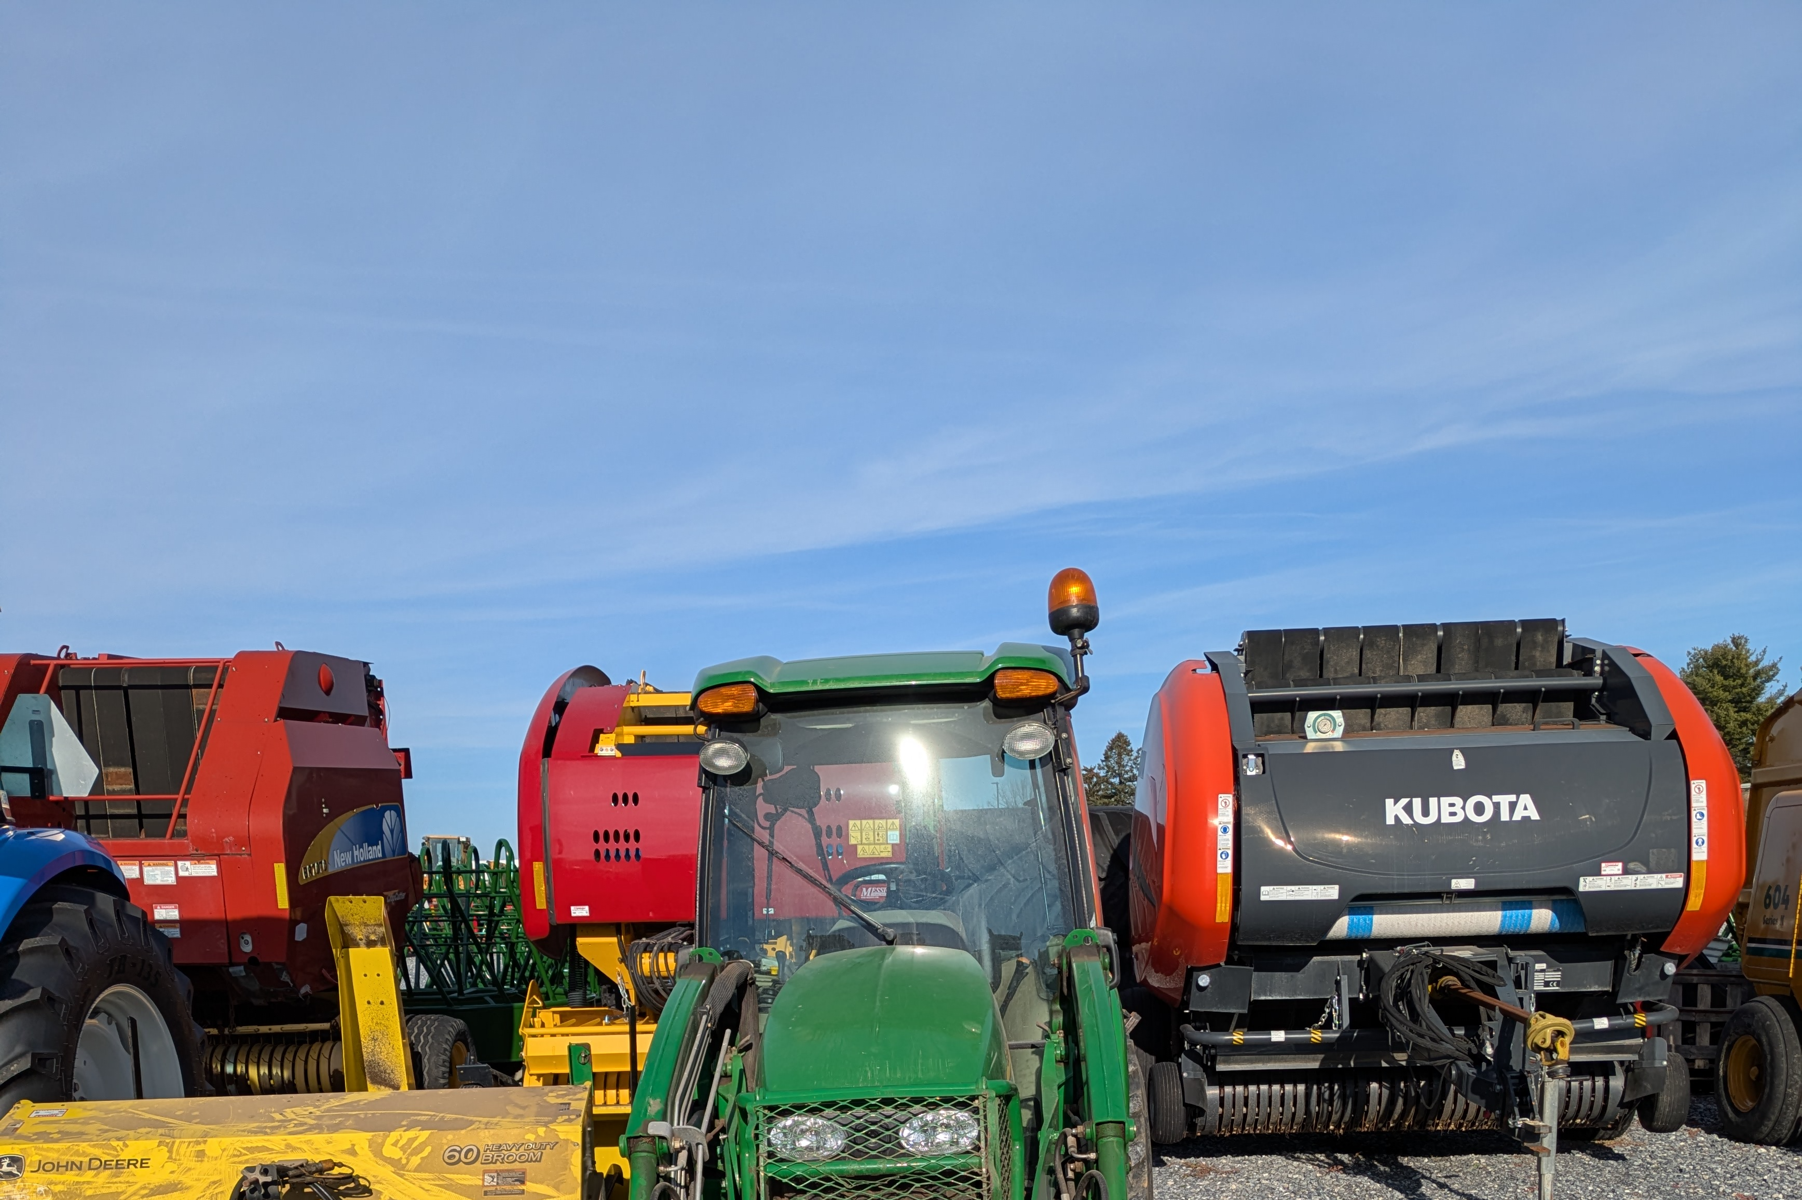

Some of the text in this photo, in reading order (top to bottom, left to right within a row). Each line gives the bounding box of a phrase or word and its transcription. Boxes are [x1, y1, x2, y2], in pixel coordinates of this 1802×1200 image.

[1385, 794, 1541, 825] KUBOTA
[333, 840, 382, 868] New Holland
[1763, 884, 1790, 910] 604
[1762, 914, 1779, 926] Series
[442, 1144, 480, 1166] 60
[484, 1141, 559, 1152] HEAVY DUTY
[30, 1156, 151, 1173] JOHN DEERE
[480, 1151, 543, 1165] BROOM
